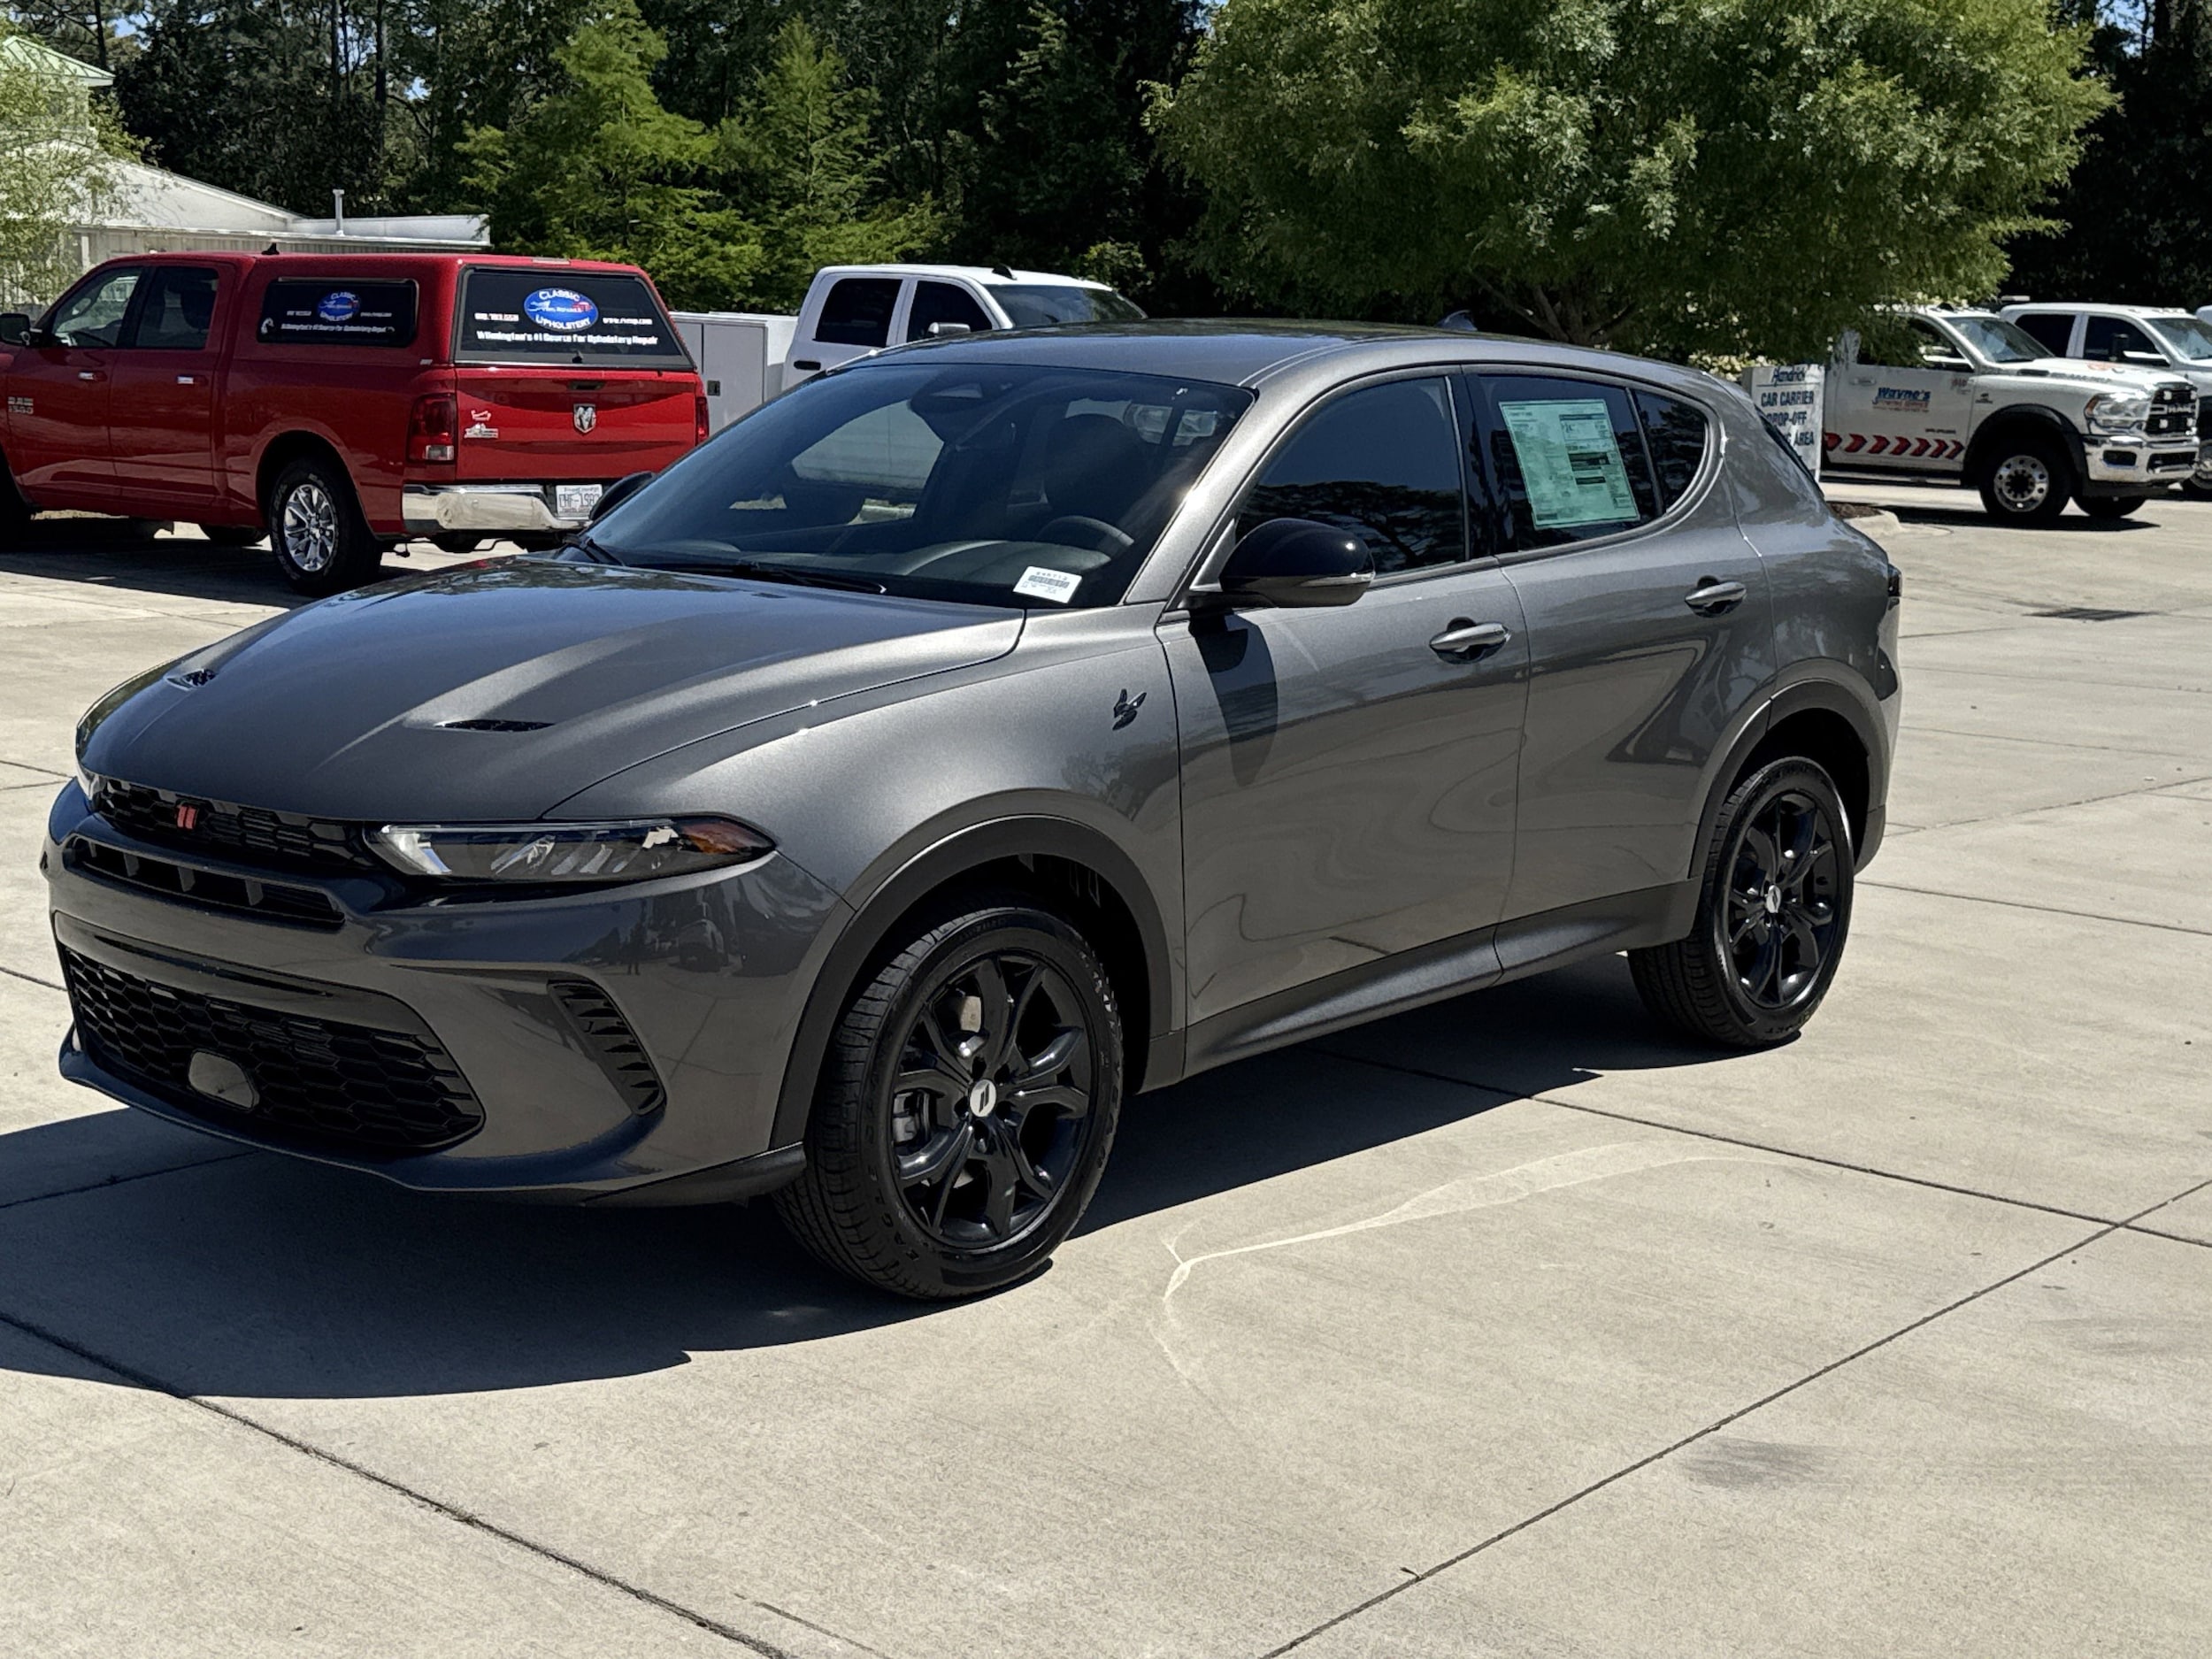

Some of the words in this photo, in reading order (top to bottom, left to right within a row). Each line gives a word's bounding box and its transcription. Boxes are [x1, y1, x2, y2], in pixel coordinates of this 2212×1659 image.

[538, 289, 580, 302] CLASSIC
[535, 313, 591, 330] UPHOLSTERY
[476, 330, 533, 342] Wilmington's
[543, 333, 572, 342] Source
[572, 334, 586, 343] for
[587, 334, 632, 345] Upholstery
[633, 335, 658, 345] Repair
[1761, 392, 1778, 407] CAR
[1779, 390, 1815, 406] CARRIER
[1875, 387, 1931, 403] Wayne's
[1794, 431, 1815, 446] AREA
